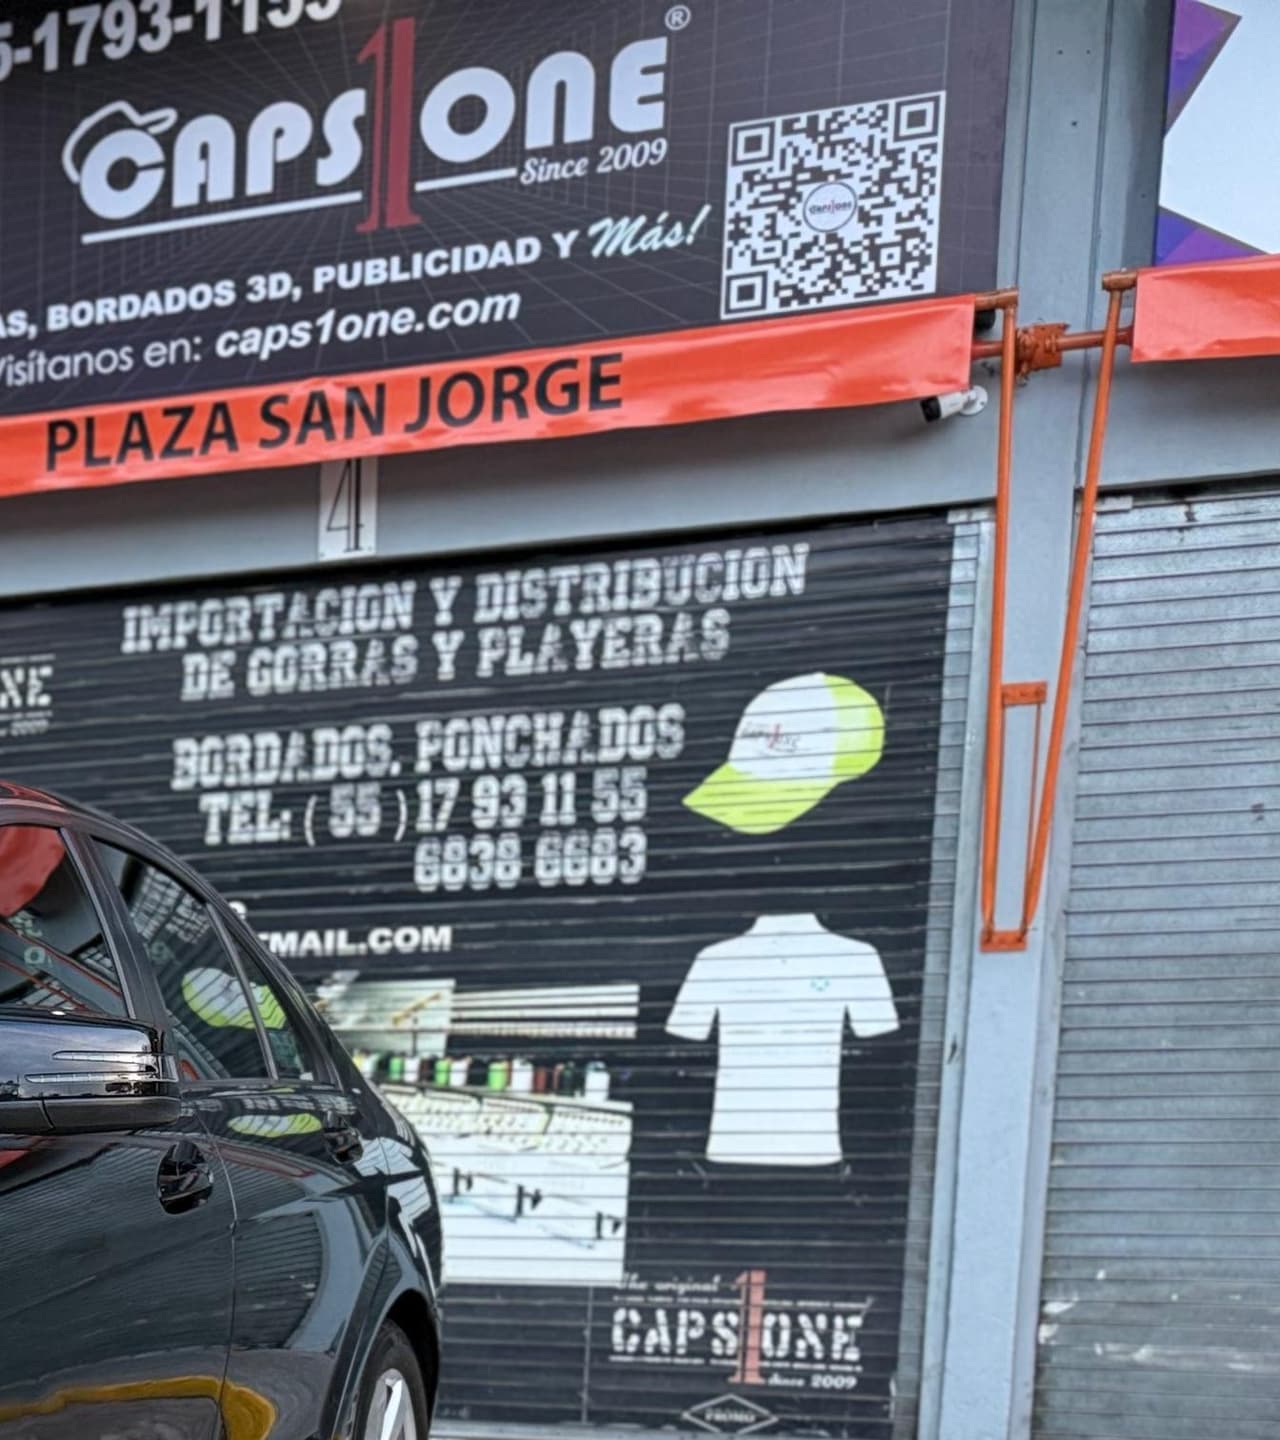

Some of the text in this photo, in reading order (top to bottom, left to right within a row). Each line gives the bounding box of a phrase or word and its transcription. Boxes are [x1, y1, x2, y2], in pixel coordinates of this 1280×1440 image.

[521, 138, 668, 185] Since 2009
[47, 280, 236, 331] BORDADOS
[246, 271, 302, 302] 3D,
[312, 236, 542, 293] PUBLICIDAD
[551, 231, 579, 259] Y
[587, 204, 712, 258] Más!
[143, 335, 202, 367] en:
[214, 291, 521, 361] caps1one.com
[44, 352, 624, 473] PLAZA SAN JORGE
[325, 457, 365, 553] 4
[120, 542, 811, 654] IMPORTACION Y DISTRIBUCION
[180, 608, 732, 702] DE GORRAS Y PLAYERAS
[413, 702, 687, 774] PONCHADOS
[198, 789, 293, 846] TEL:
[415, 777, 461, 833] 17
[471, 773, 527, 830] 93
[539, 771, 577, 827] 11
[590, 766, 648, 824] 55
[413, 833, 523, 893] 6838
[257, 925, 453, 958] MAIL.COM
[810, 1374, 858, 1389] 2009
